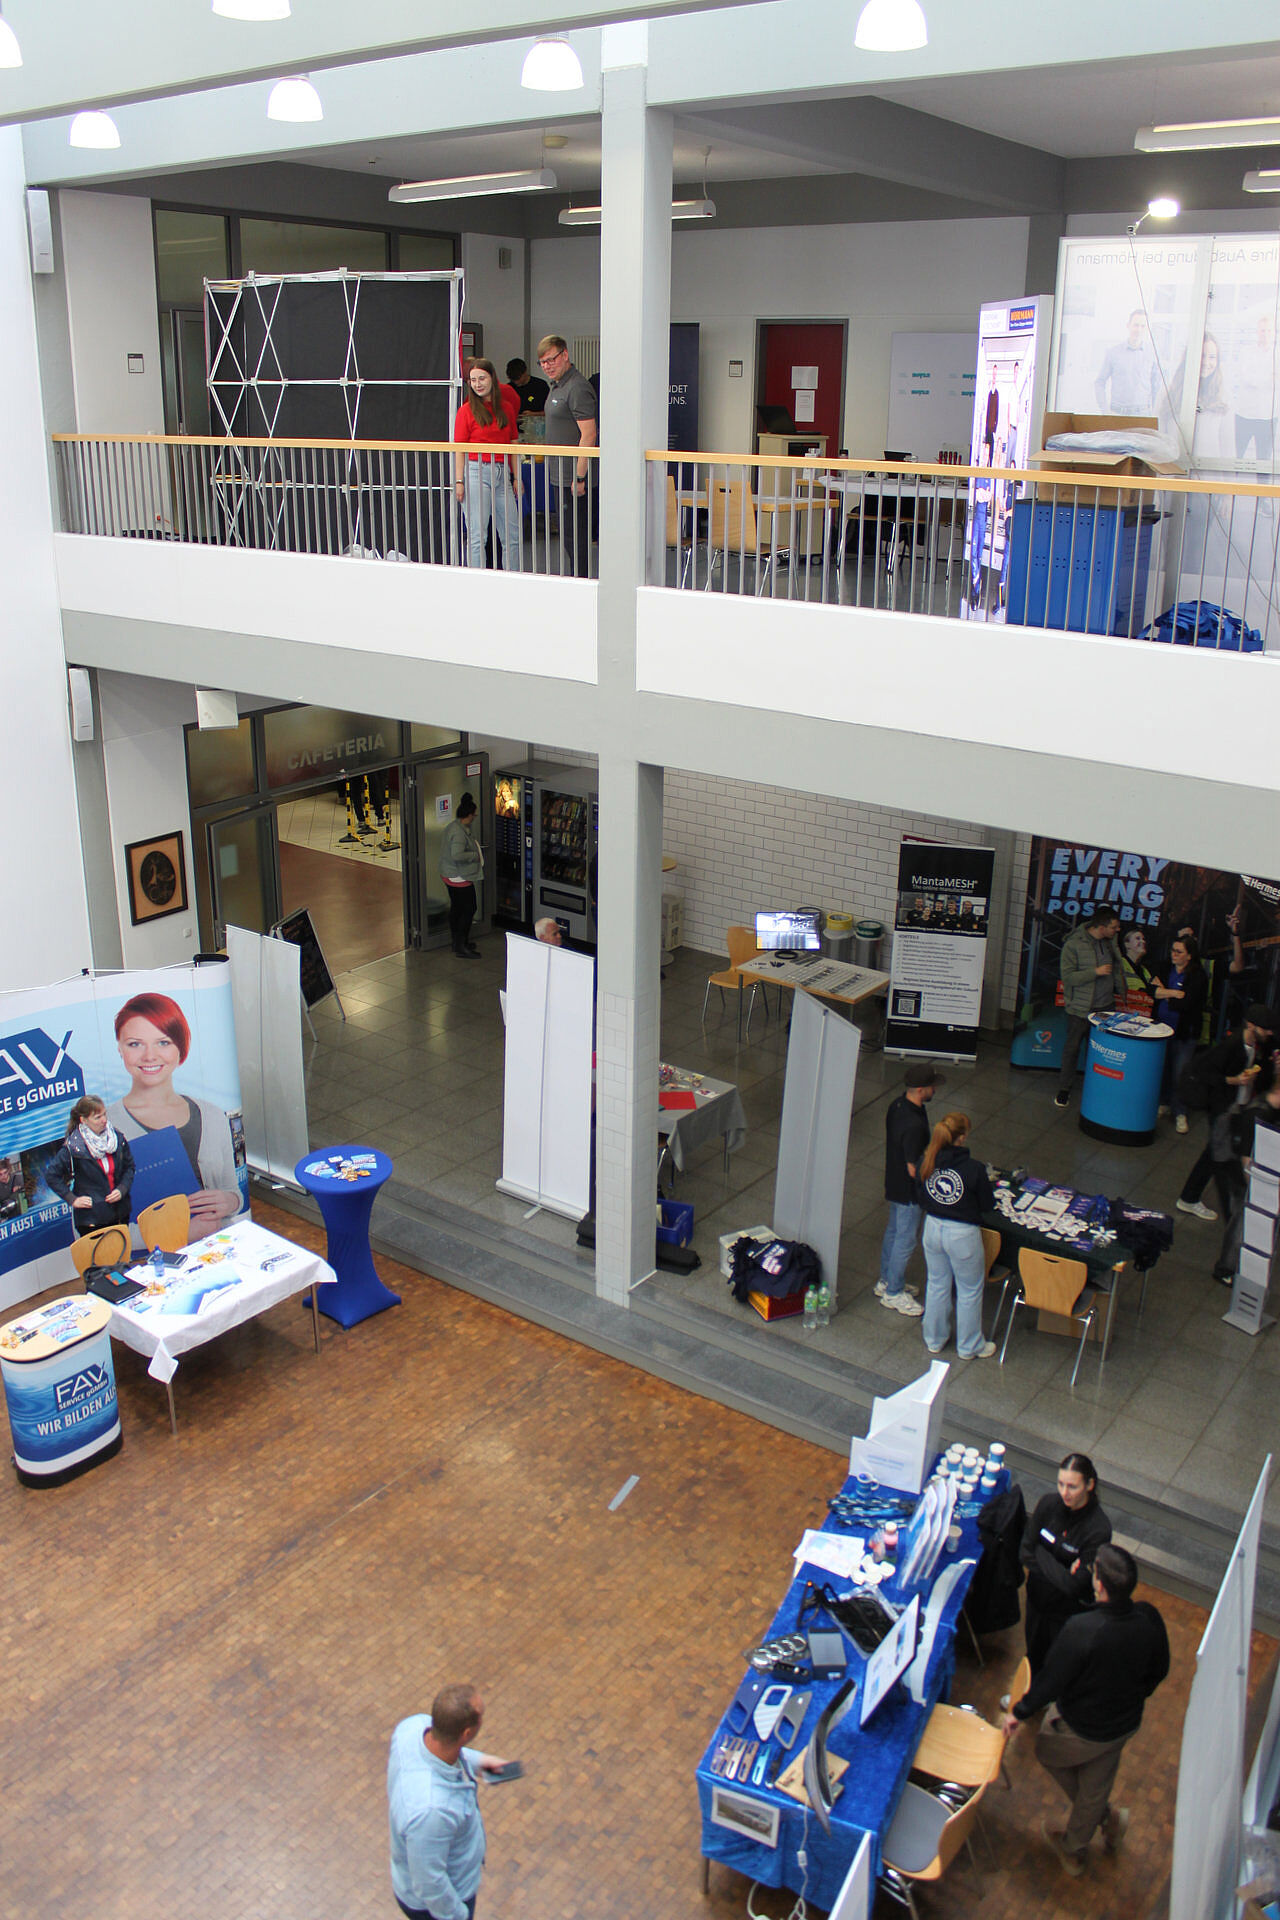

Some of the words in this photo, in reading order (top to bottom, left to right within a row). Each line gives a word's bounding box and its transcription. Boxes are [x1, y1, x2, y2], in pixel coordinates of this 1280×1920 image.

[287, 733, 385, 770] CAFETERIA
[1051, 847, 1170, 882] EVERY
[1050, 873, 1165, 908] THING
[1047, 898, 1161, 927] POSBLE
[16, 1077, 78, 1111] gGMBH
[11, 1215, 34, 1236] AUS!
[39, 1205, 60, 1223] WIR
[56, 1361, 105, 1403] FAV
[37, 1418, 62, 1436] WIR
[64, 1396, 103, 1428] BILDEN
[58, 1392, 86, 1411] SERVICE
